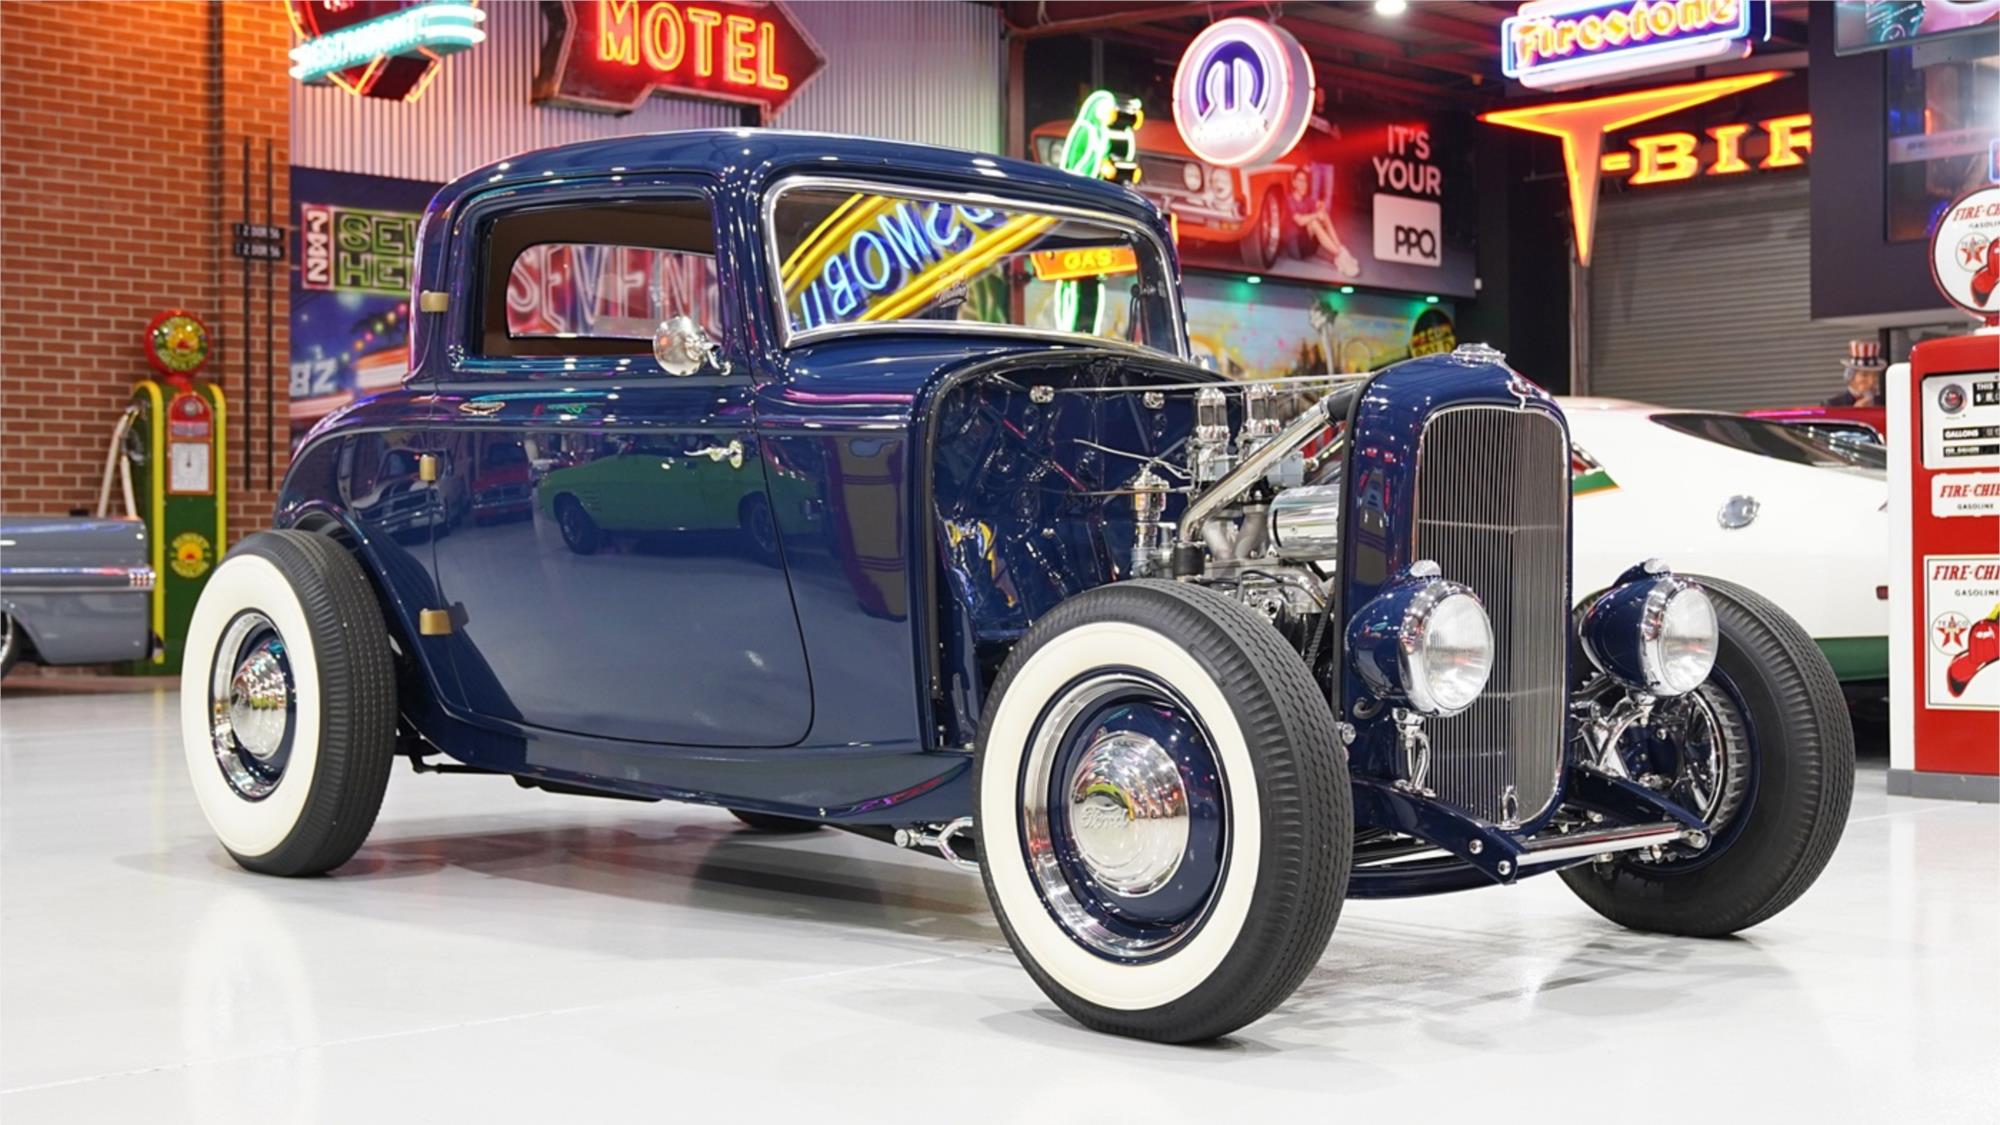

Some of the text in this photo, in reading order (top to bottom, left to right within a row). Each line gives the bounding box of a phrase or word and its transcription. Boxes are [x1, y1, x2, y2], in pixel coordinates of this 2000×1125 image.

[597, 0, 790, 91] MOTEL
[1512, 0, 1739, 69] Firestone
[1388, 124, 1430, 160] IT'S
[1372, 156, 1442, 196] YOUR
[1063, 247, 1113, 270] GAS
[1394, 224, 1437, 260] PPQ
[1944, 429, 1980, 439] GALLONS
